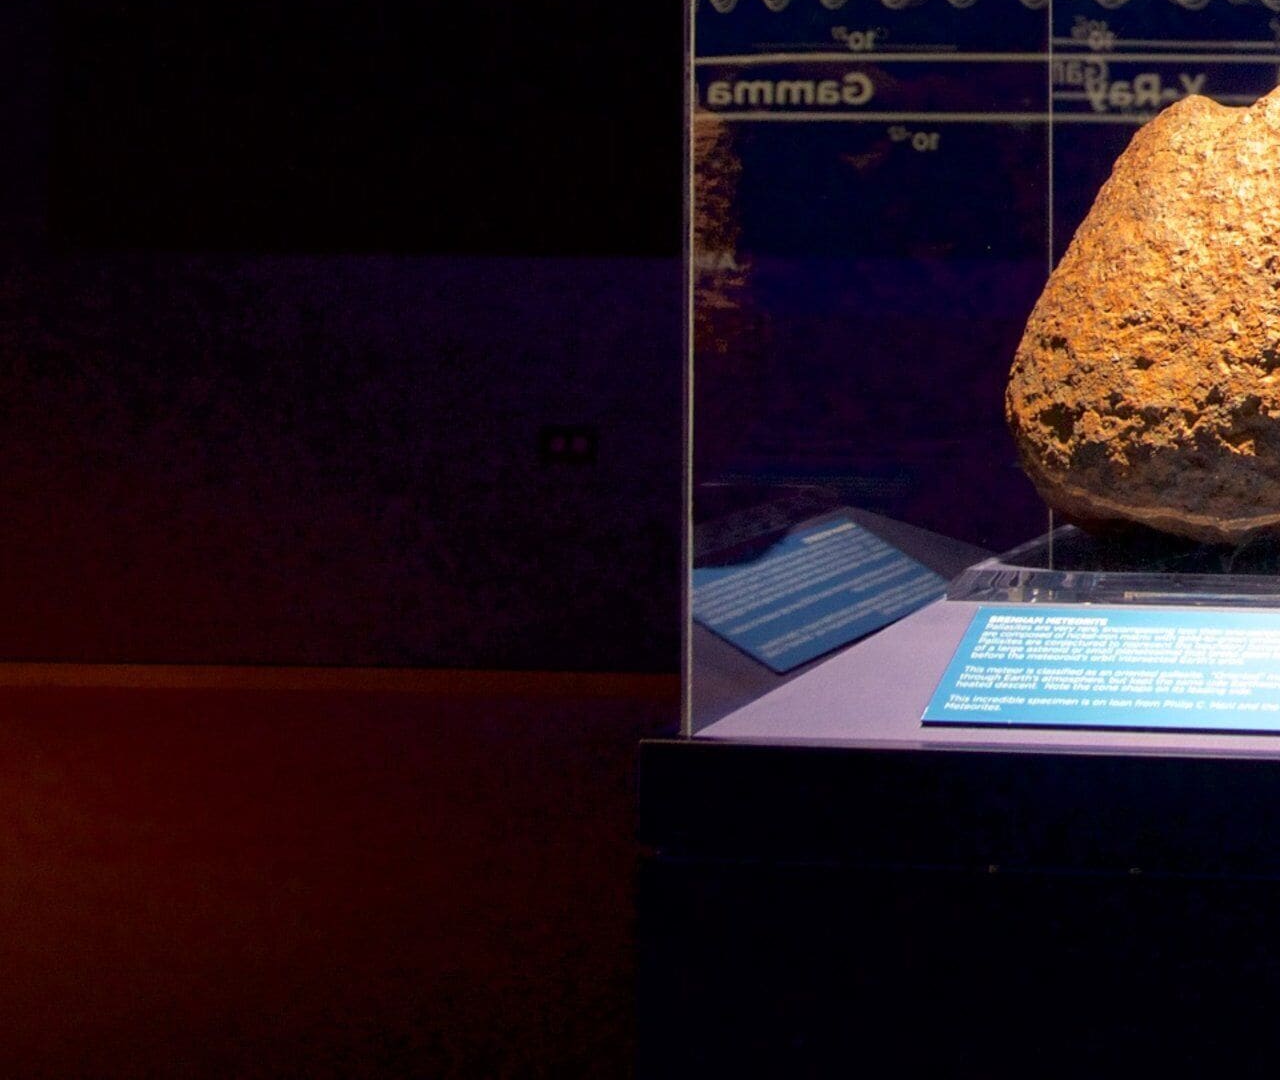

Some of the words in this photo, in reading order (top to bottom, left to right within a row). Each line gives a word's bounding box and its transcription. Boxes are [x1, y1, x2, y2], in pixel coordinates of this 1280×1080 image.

[1045, 616, 1109, 626] METEORITE
[986, 666, 1024, 674] meteor
[956, 681, 994, 689] heated
[950, 694, 970, 702] This
[972, 695, 1025, 704] incredible
[1027, 697, 1079, 706] specimen
[1081, 698, 1090, 706] is
[1108, 699, 1132, 707] loan
[1134, 700, 1161, 708] from
[944, 702, 1002, 712] Meteorites.
